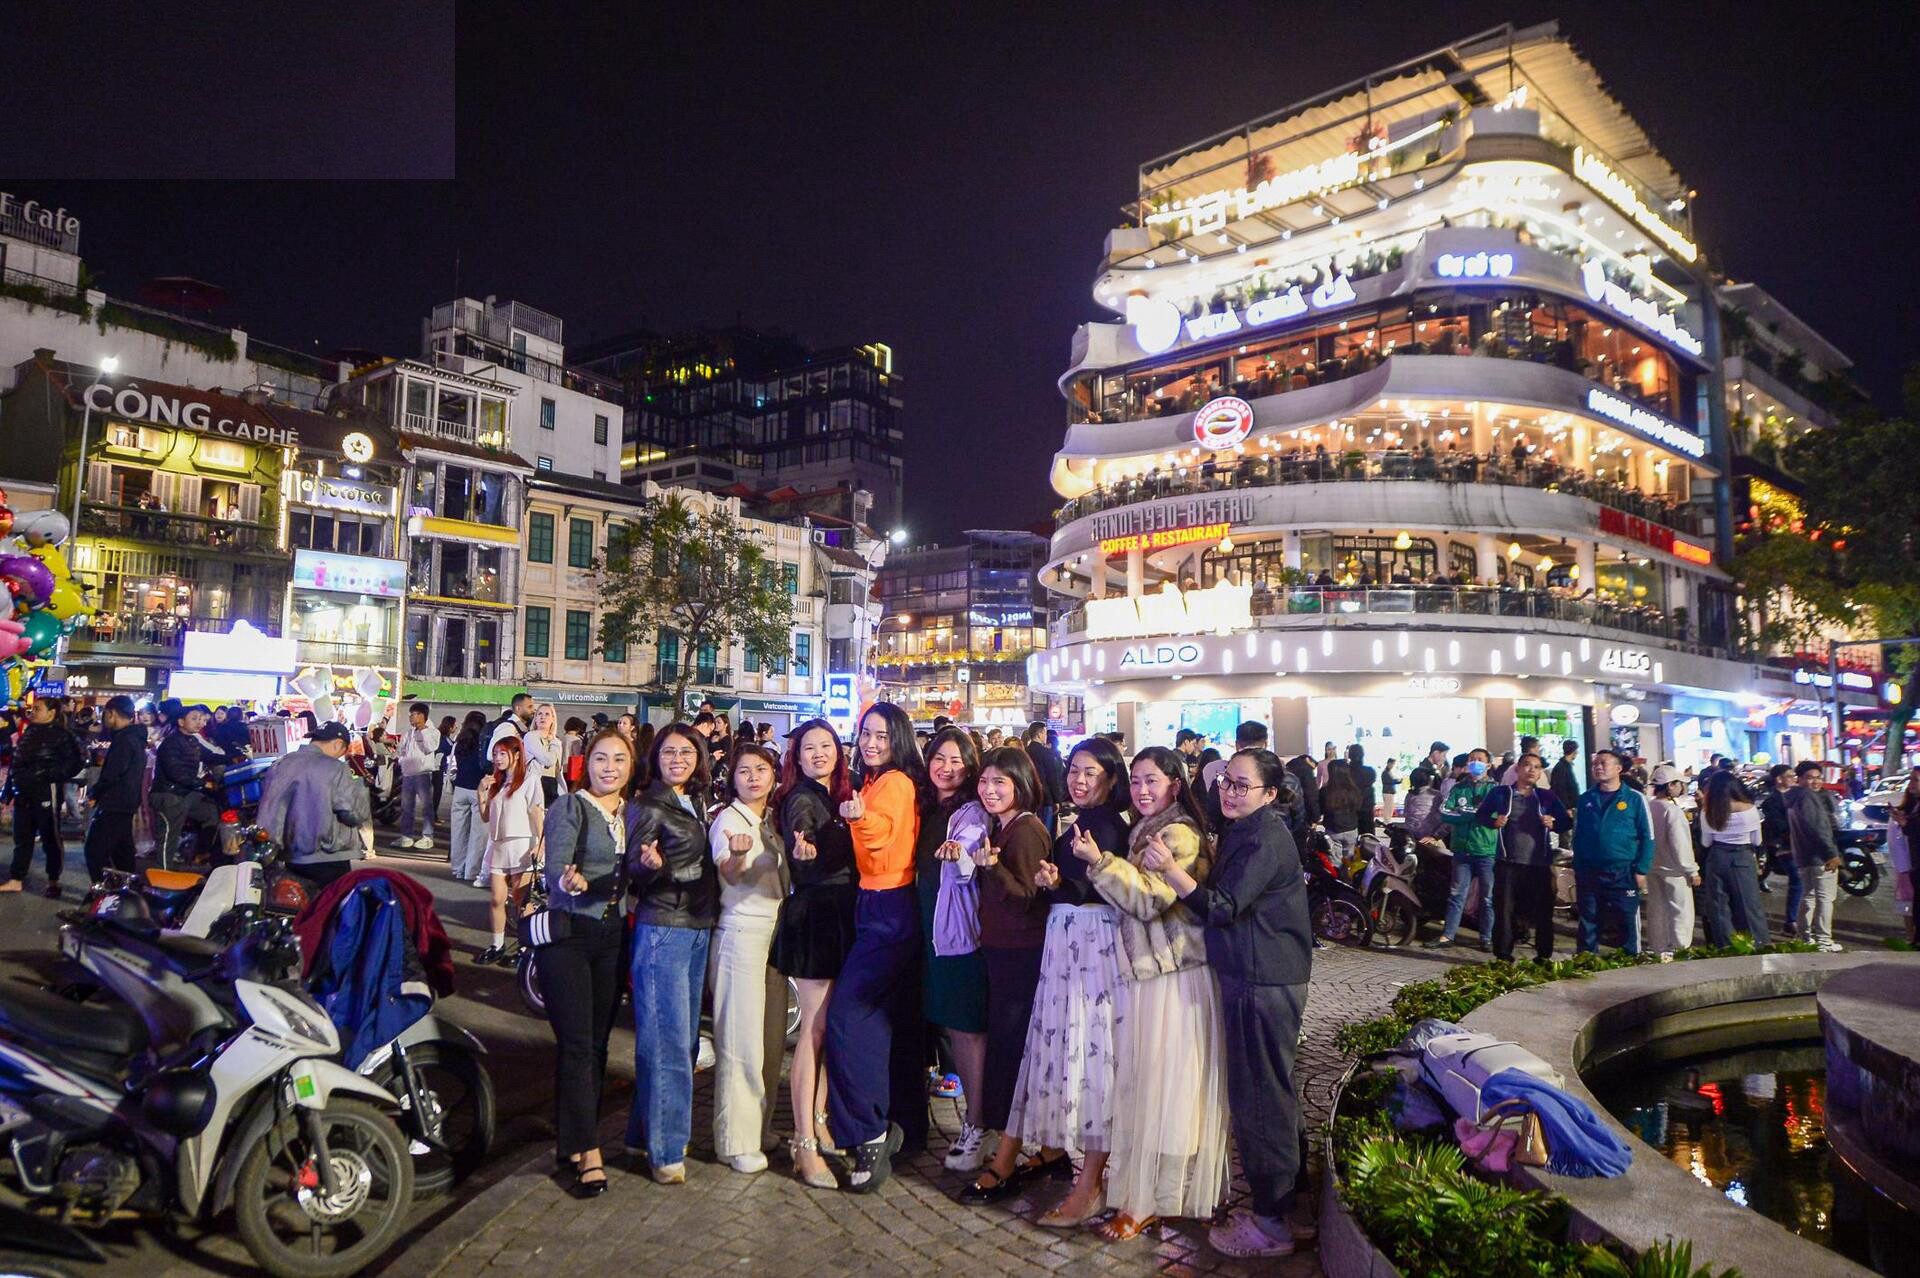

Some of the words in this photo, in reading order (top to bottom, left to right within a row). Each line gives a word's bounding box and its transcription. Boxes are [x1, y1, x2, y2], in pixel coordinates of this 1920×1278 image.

[24, 200, 80, 236] Cafe
[1101, 535, 1138, 553] COFFEE
[1141, 534, 1150, 548] &
[1153, 522, 1231, 548] RESTAURANT
[1120, 645, 1198, 666] ALDO
[558, 692, 608, 702] Vietcombank
[763, 702, 799, 711] Vietcombank
